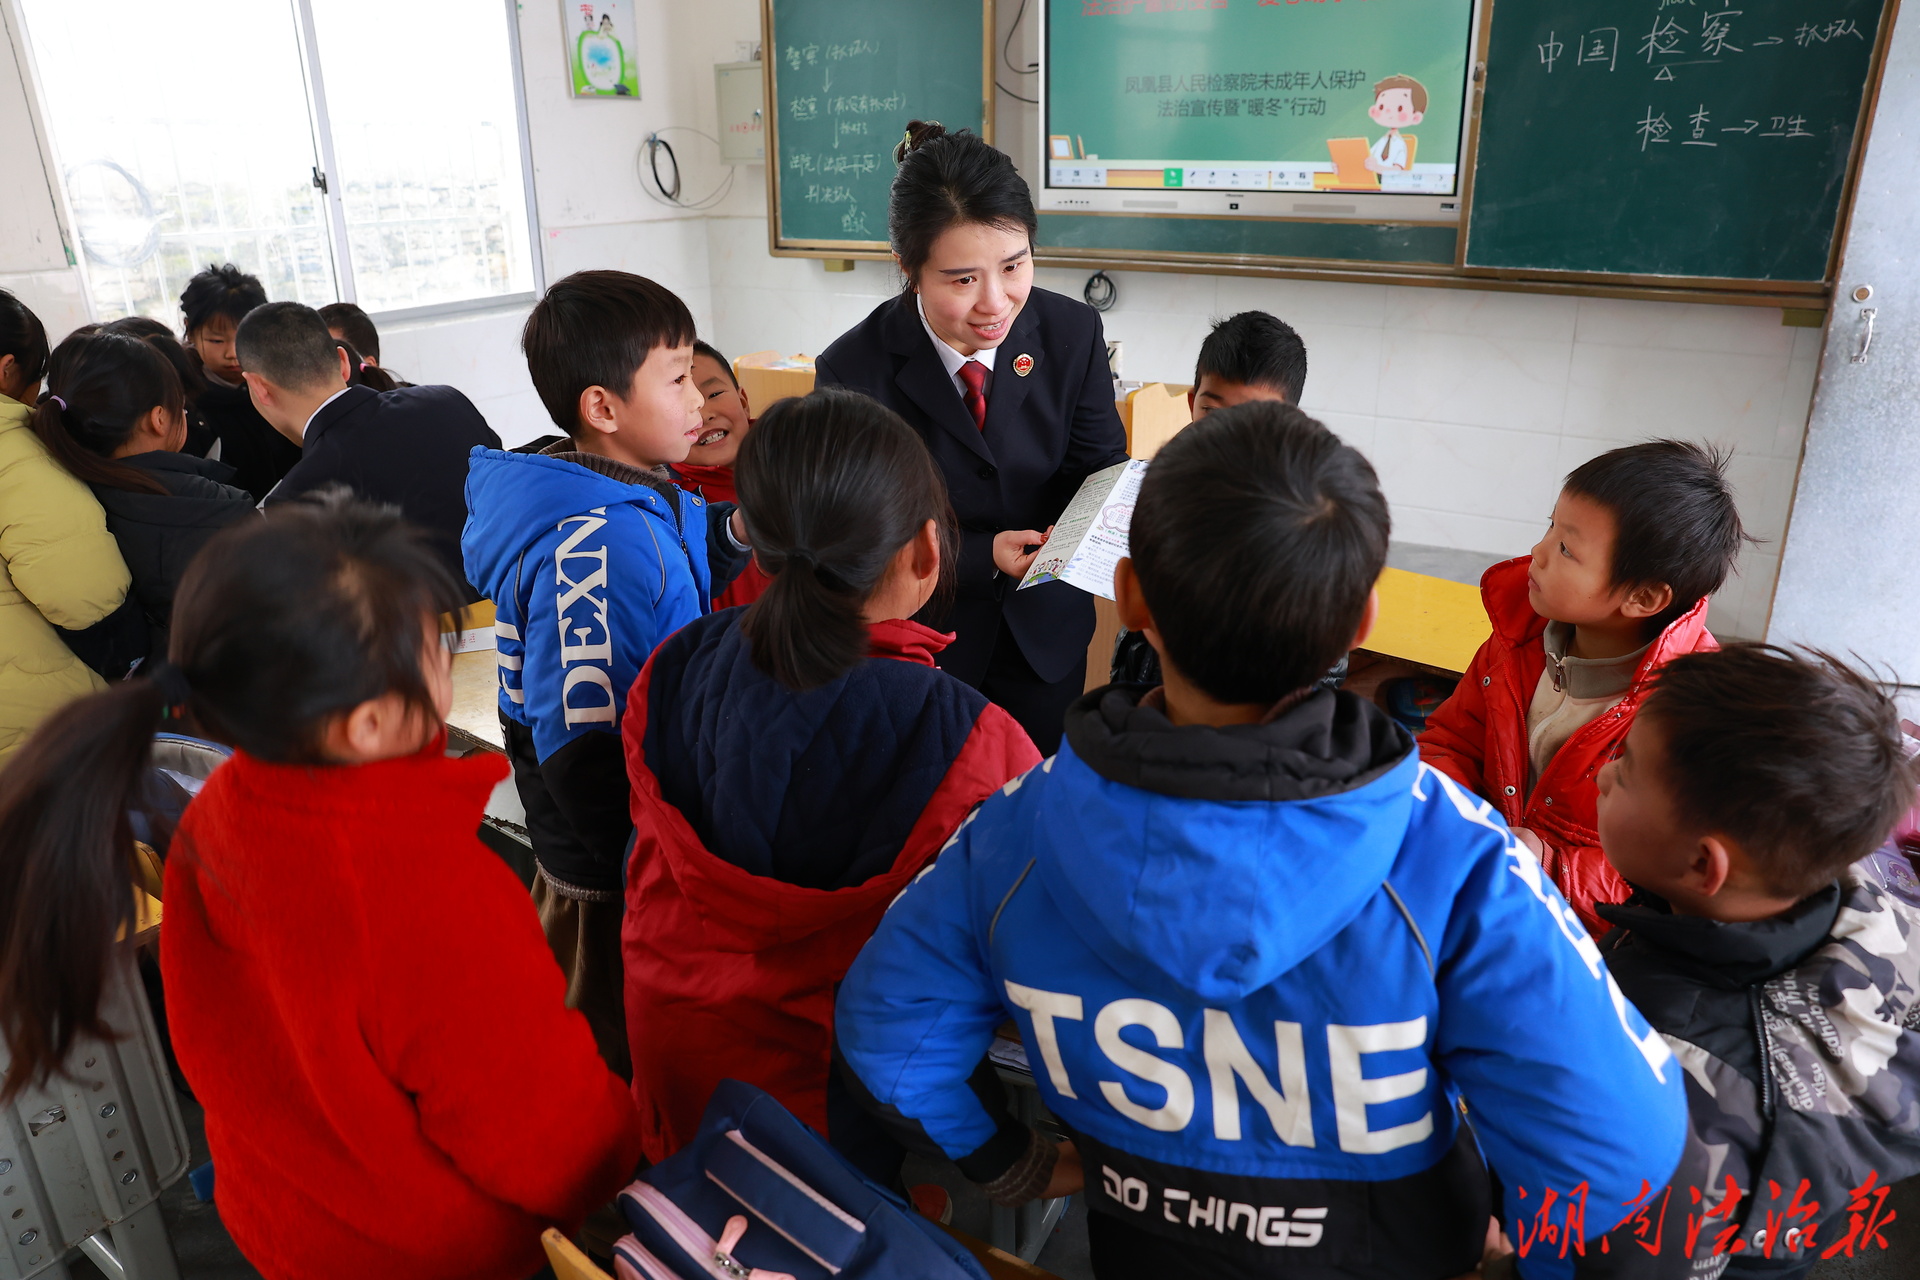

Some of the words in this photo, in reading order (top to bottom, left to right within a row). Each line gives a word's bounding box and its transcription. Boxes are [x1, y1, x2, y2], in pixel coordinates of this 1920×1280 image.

[1125, 69, 1366, 95] 凤凰县人民检察院未成年人保护
[1637, 104, 1718, 152] 检查
[1759, 115, 1815, 138] 卫生
[1004, 979, 1434, 1154] TSNE
